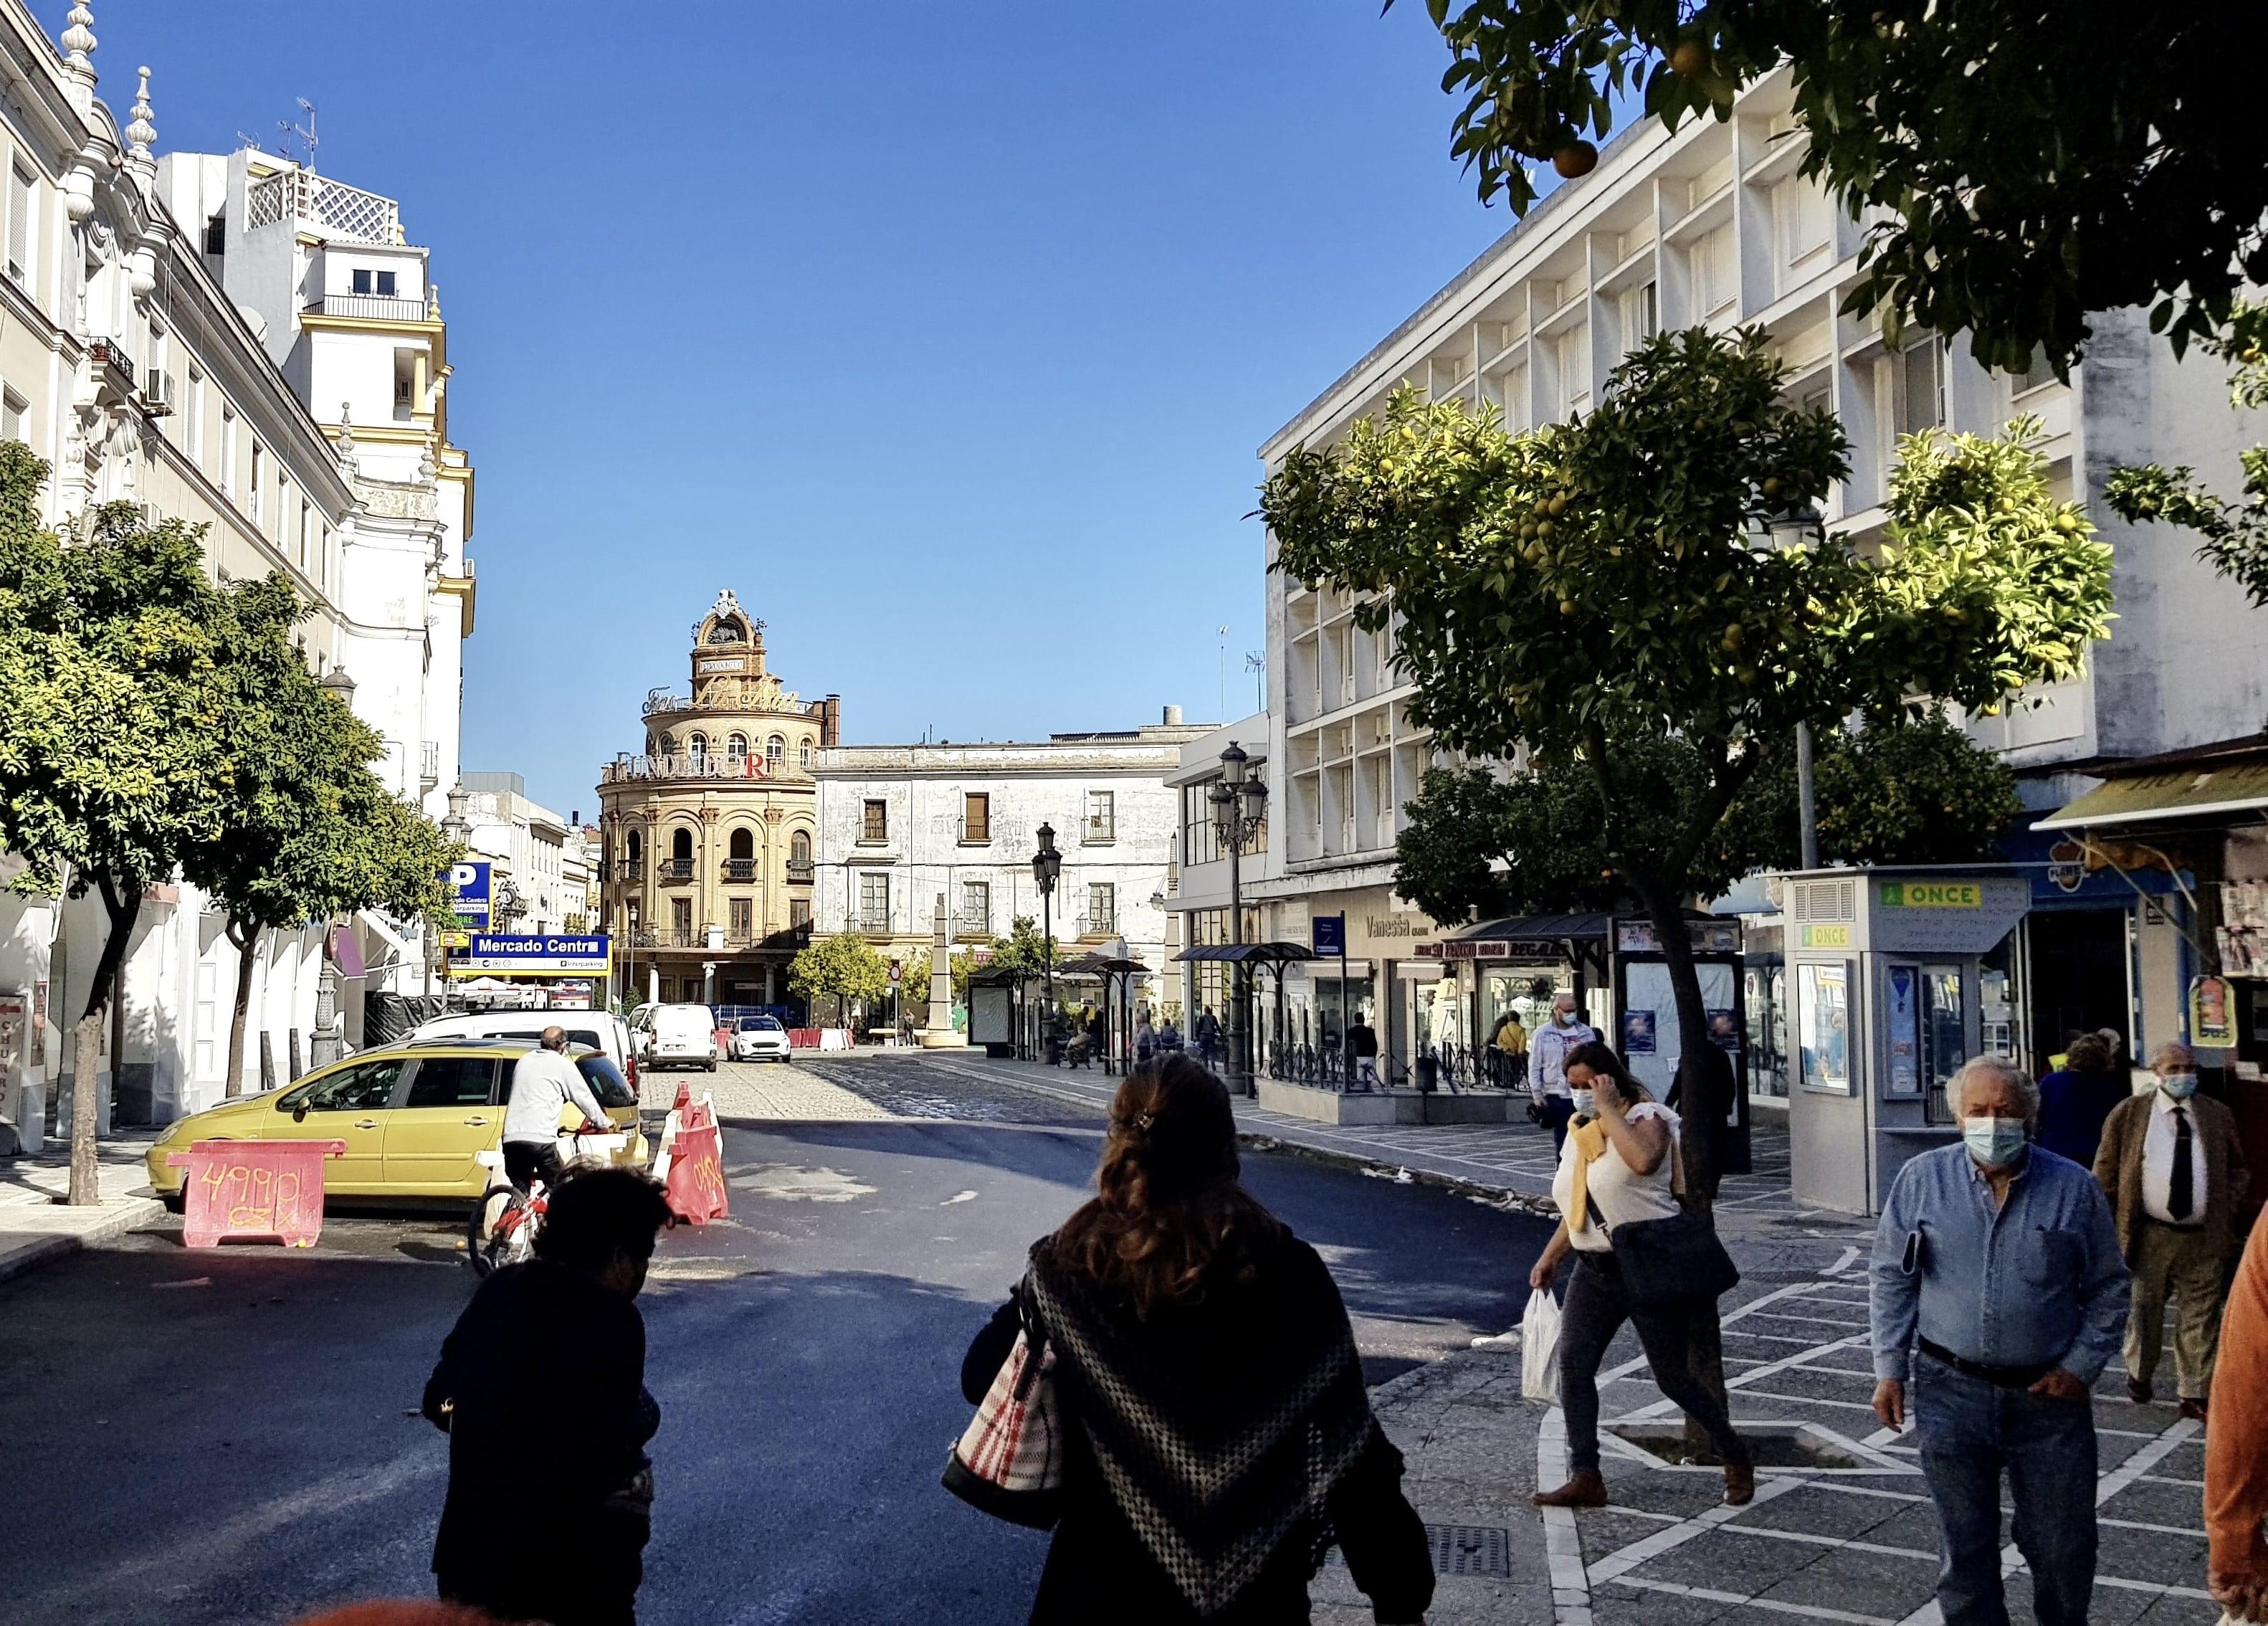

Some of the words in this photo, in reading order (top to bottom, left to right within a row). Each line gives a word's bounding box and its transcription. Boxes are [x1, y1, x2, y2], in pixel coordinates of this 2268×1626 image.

[616, 751, 766, 782] FUNDADOR
[1912, 886, 1973, 903] ONCE
[456, 916, 473, 924] IBRE
[1816, 928, 1846, 943] ONCE
[479, 939, 543, 953] Mercado
[0, 1020, 10, 1116] CHURRO
